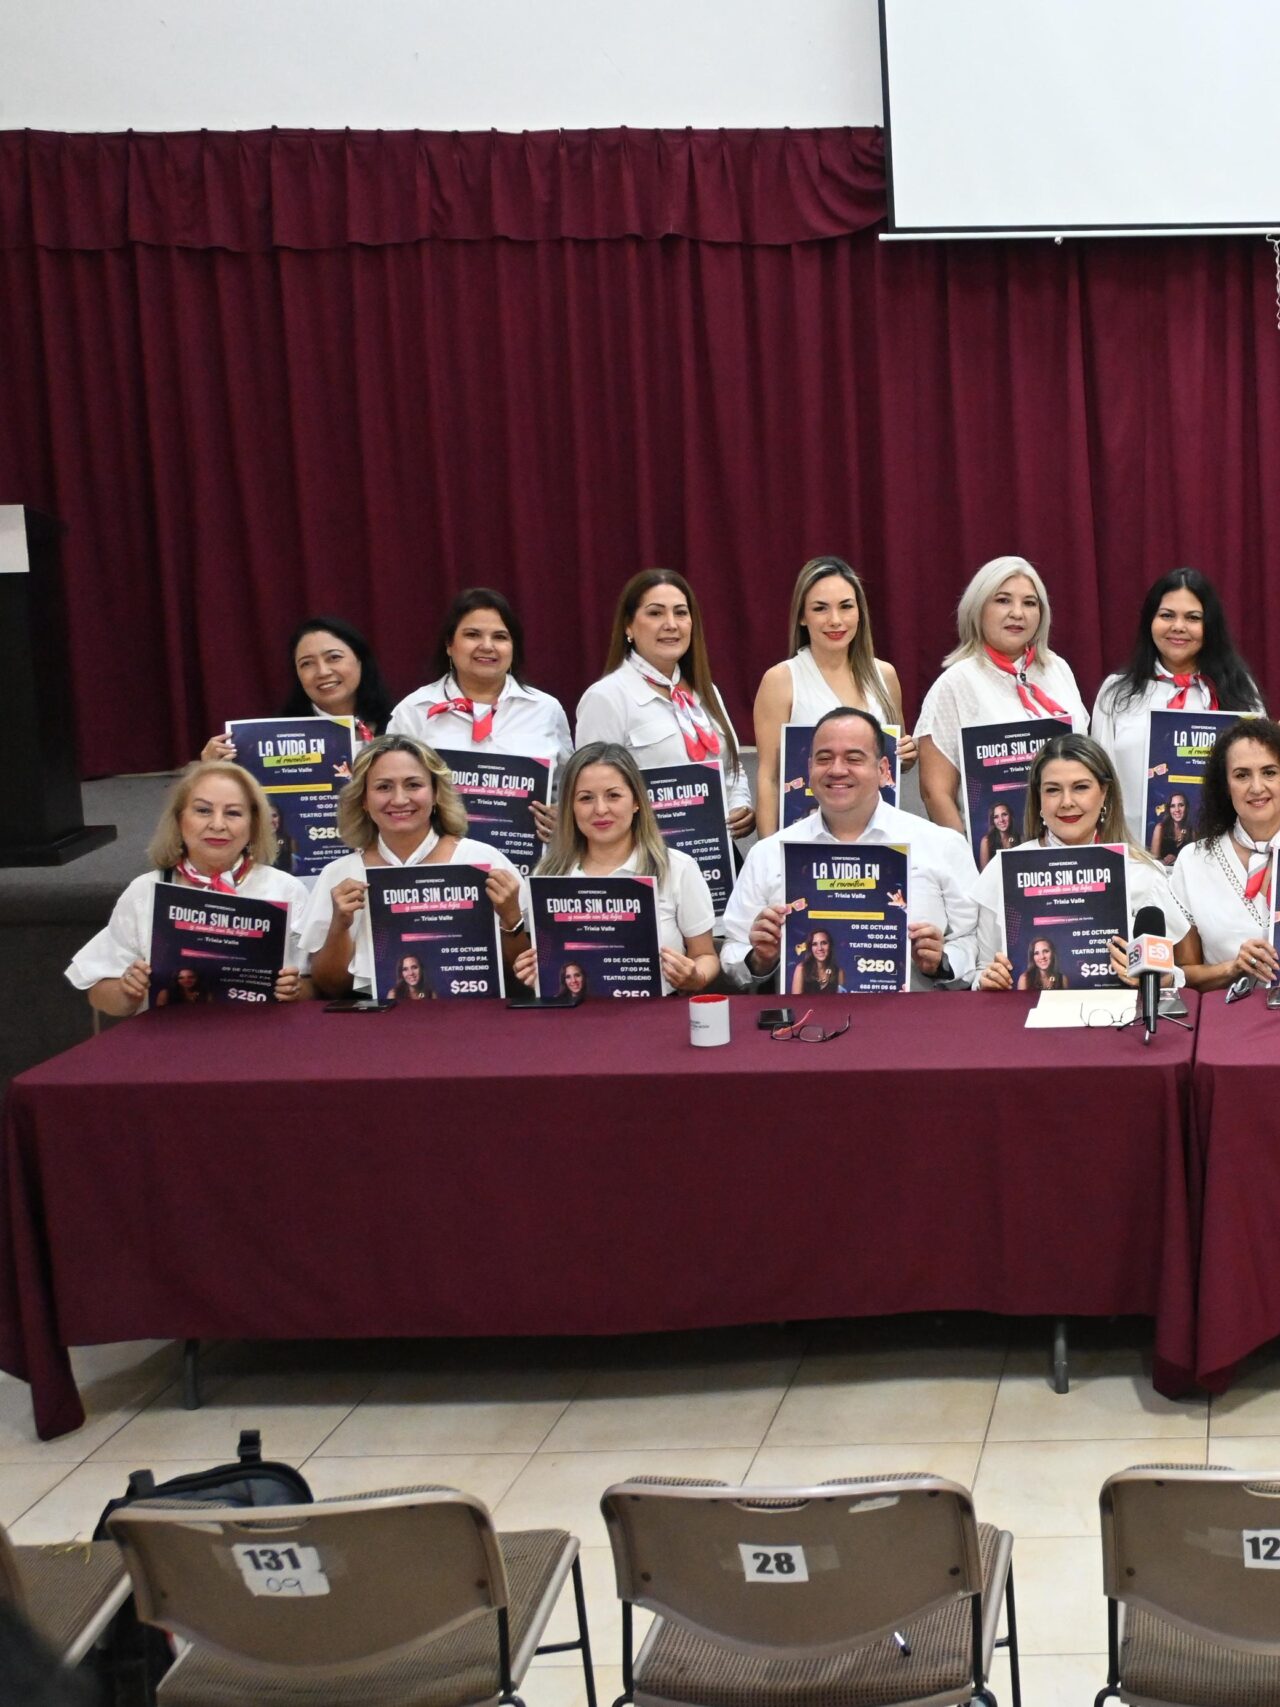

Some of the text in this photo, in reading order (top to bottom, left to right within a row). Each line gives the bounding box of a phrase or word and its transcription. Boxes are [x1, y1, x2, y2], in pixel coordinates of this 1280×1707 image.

[258, 739, 325, 757] LA VIDA EN
[1174, 731, 1216, 747] LA VIDA
[976, 743, 1008, 759] EDUCA
[1011, 741, 1026, 755] SIN
[451, 771, 534, 791] DUCA SIN CULPA
[657, 787, 674, 801] SIN
[676, 783, 709, 799] CULPA
[813, 862, 880, 880] LA VIDA EN
[1017, 868, 1111, 888] EDUCA SIN CULPA
[383, 886, 478, 905] EDUCA SIN CULPA
[547, 899, 641, 913] EDUCA SIN CULPA
[169, 905, 206, 924] EDUCA
[210, 913, 229, 928] SIN
[232, 916, 270, 932] CULPA
[857, 958, 895, 973] $250
[451, 980, 488, 994] $250
[242, 1548, 301, 1571] 131
[752, 1552, 795, 1574] 28
